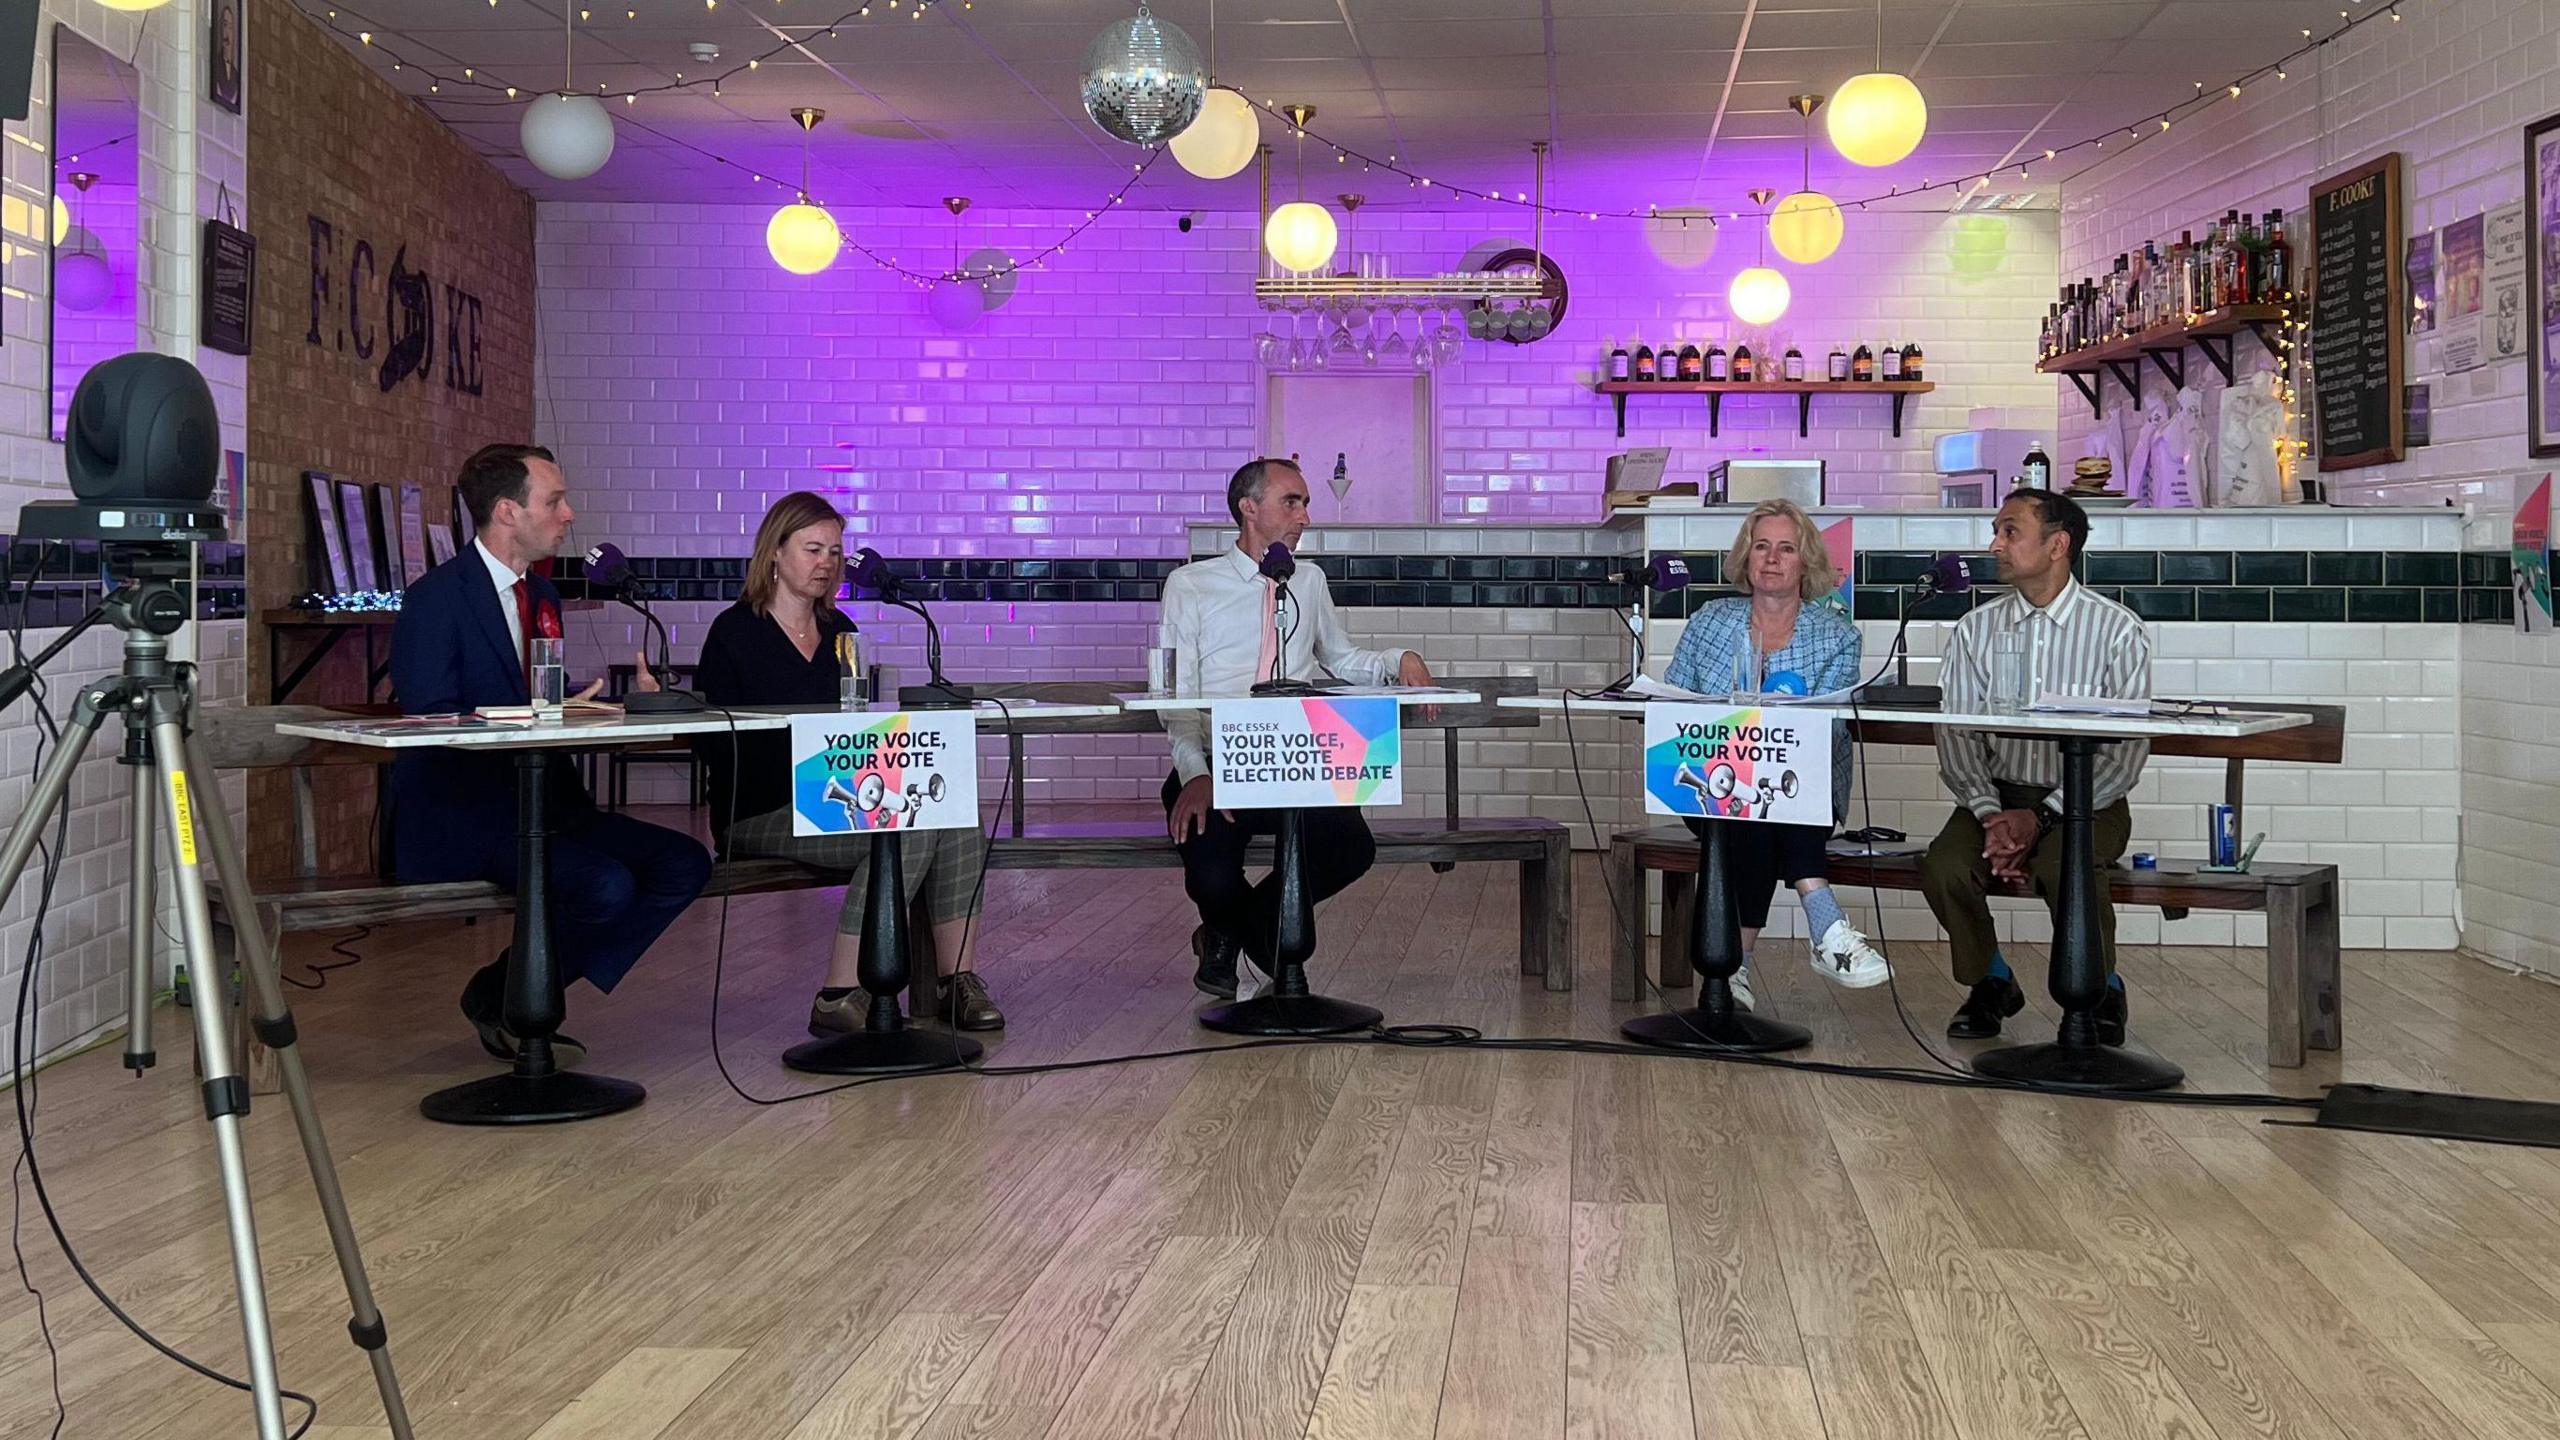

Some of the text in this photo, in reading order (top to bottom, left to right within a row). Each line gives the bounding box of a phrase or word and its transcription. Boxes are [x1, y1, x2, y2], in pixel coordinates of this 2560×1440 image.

[2340, 176, 2376, 207] COOKE
[1222, 722, 1280, 732] BBC ESSEX
[1676, 722, 1800, 748] YOUR VOICE,
[824, 731, 946, 751] YOUR VOICE,
[1222, 733, 1345, 750] YOUR VOICE,
[824, 751, 934, 771] YOUR VOTE
[1222, 750, 1332, 766] YOUR VOTE
[1675, 742, 1787, 763] YOUR VOTE
[1222, 765, 1393, 783] ELECTION DEBATE
